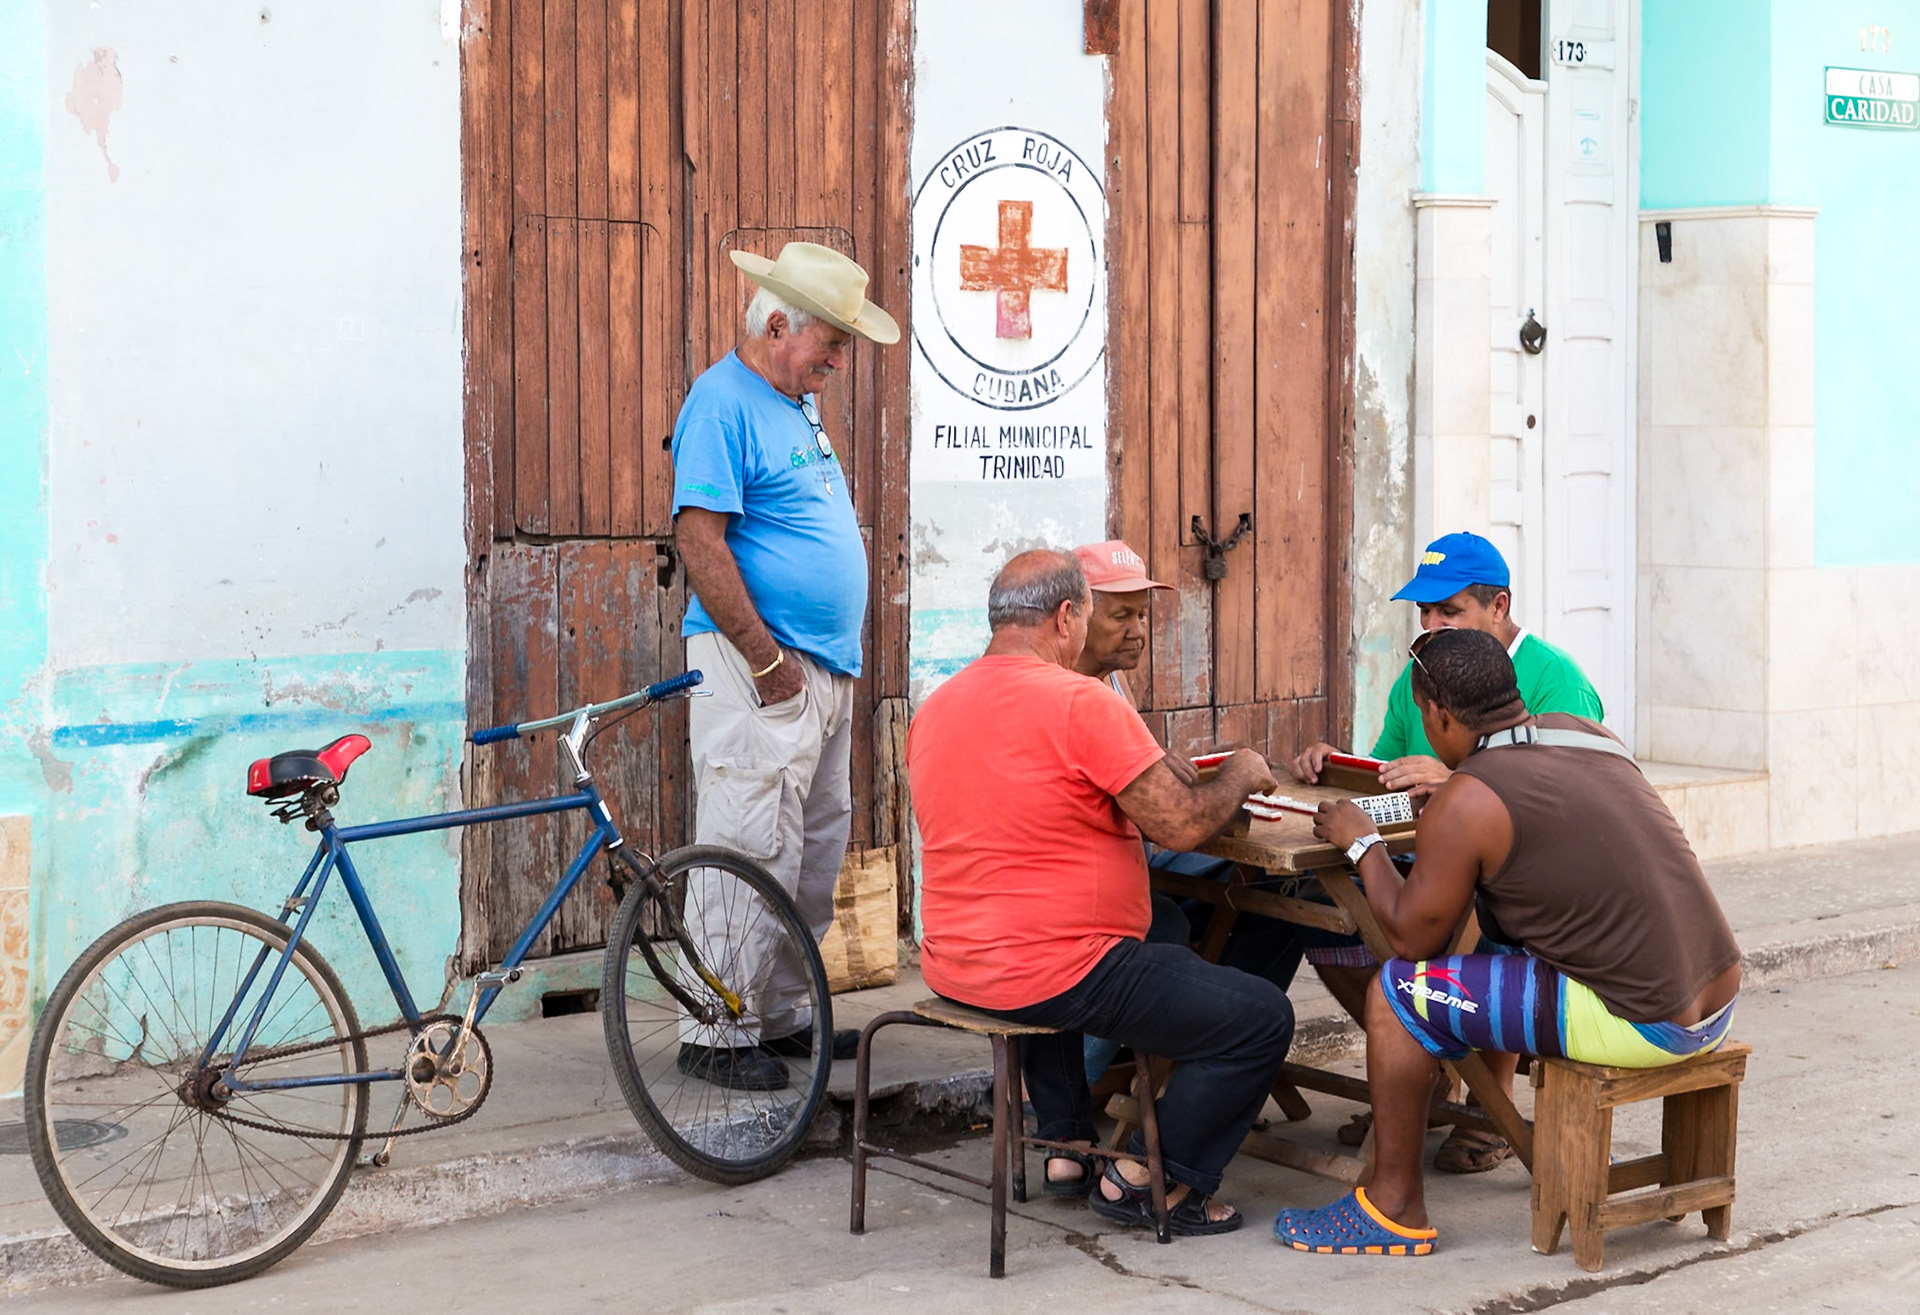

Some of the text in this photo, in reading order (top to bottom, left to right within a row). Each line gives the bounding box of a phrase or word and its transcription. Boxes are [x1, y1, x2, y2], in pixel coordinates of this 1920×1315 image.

[1559, 40, 1584, 62] 173
[1860, 75, 1893, 96] CASA
[1831, 98, 1914, 123] CARIDAD
[940, 137, 1072, 188] CRUZ ROJA
[973, 369, 1065, 403] CUBANA
[935, 425, 1093, 449] FILIAL MUNICIPAL
[979, 455, 1065, 479] TRINIDAD
[1398, 978, 1479, 1013] XTREME
